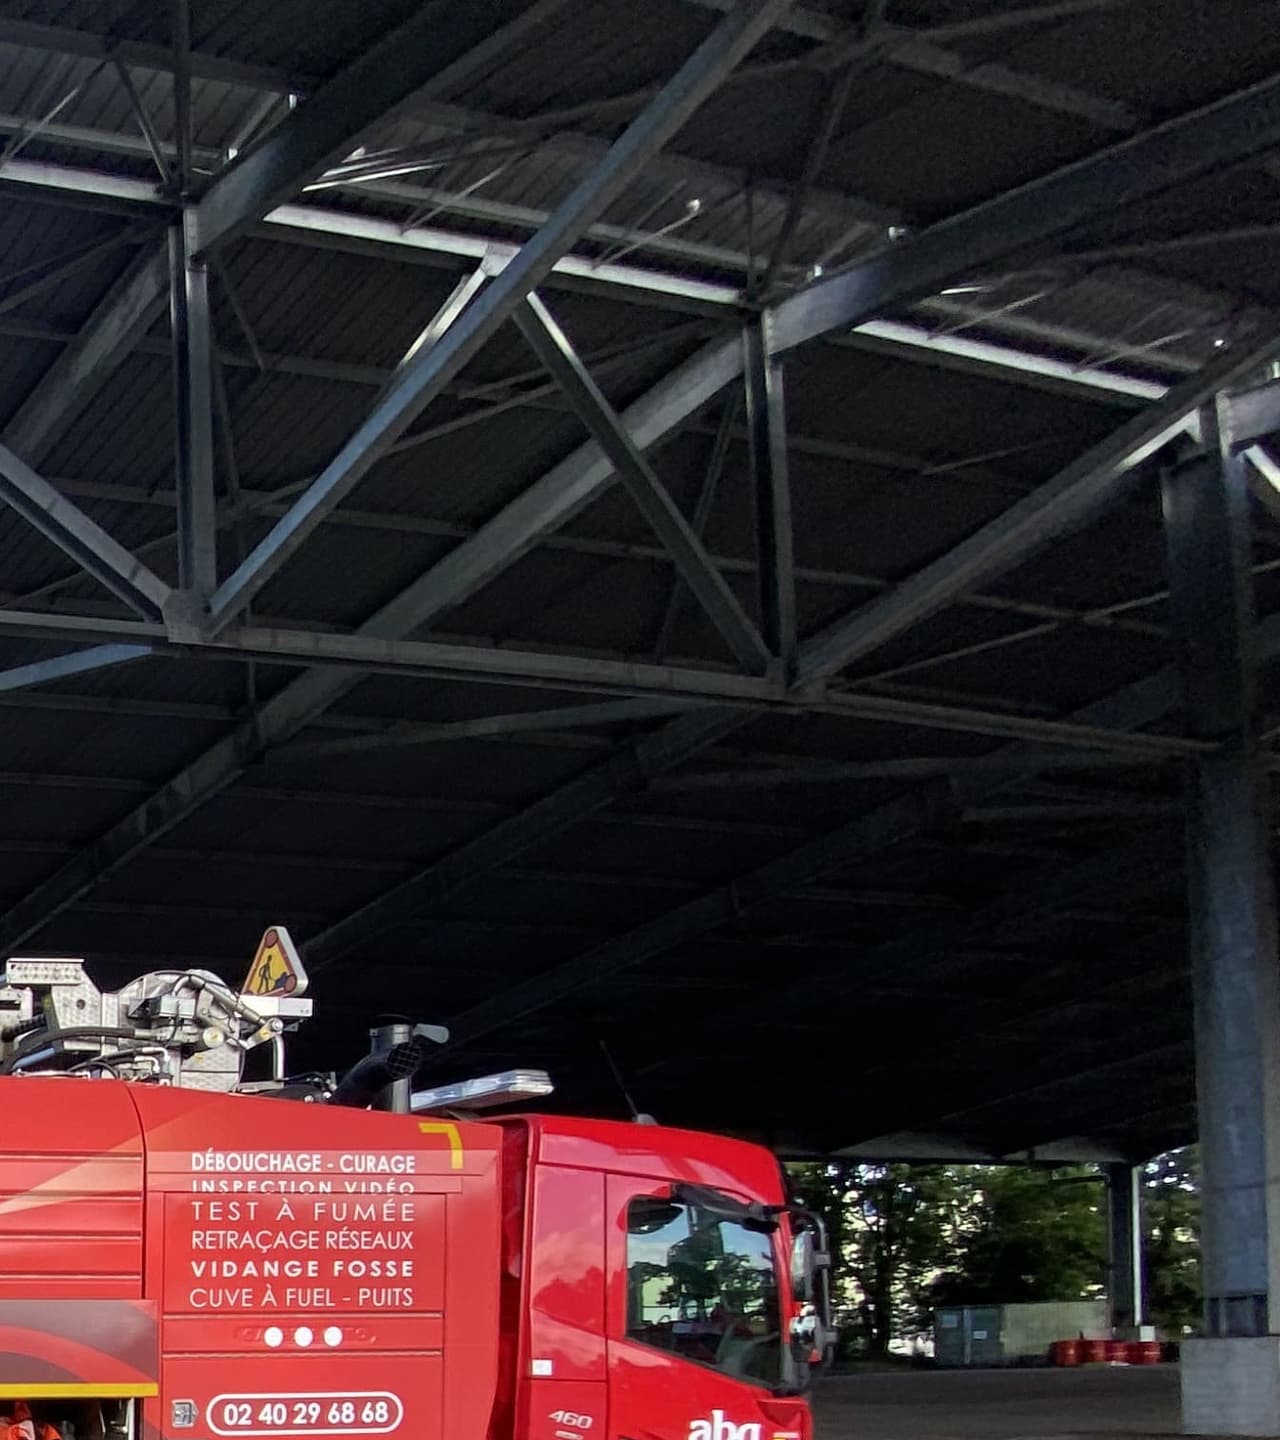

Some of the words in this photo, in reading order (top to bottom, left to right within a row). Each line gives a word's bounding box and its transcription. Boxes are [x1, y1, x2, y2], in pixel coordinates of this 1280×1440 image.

[191, 1147, 322, 1173] DÉBOUCHAGE
[340, 1154, 416, 1174] CURAGE
[192, 1179, 332, 1195] INSPECTION
[344, 1178, 415, 1196] VIDÉO
[192, 1201, 259, 1221] TEST
[276, 1198, 295, 1221] À
[314, 1198, 415, 1221] FUMÉE
[191, 1229, 320, 1253] RETRAÇAGE
[326, 1226, 414, 1249] RÉSEAUX
[191, 1260, 319, 1278] VIDANGE
[333, 1260, 413, 1278] FOSSE
[190, 1288, 253, 1307] CUVE
[261, 1283, 278, 1307] À
[286, 1288, 336, 1307] FUEL
[359, 1287, 413, 1307] PUITS
[223, 1403, 252, 1426] 02
[258, 1403, 287, 1425] 40
[293, 1402, 320, 1425] 29
[328, 1402, 355, 1424] 68
[361, 1401, 388, 1424] 68
[548, 1410, 593, 1429] 460
